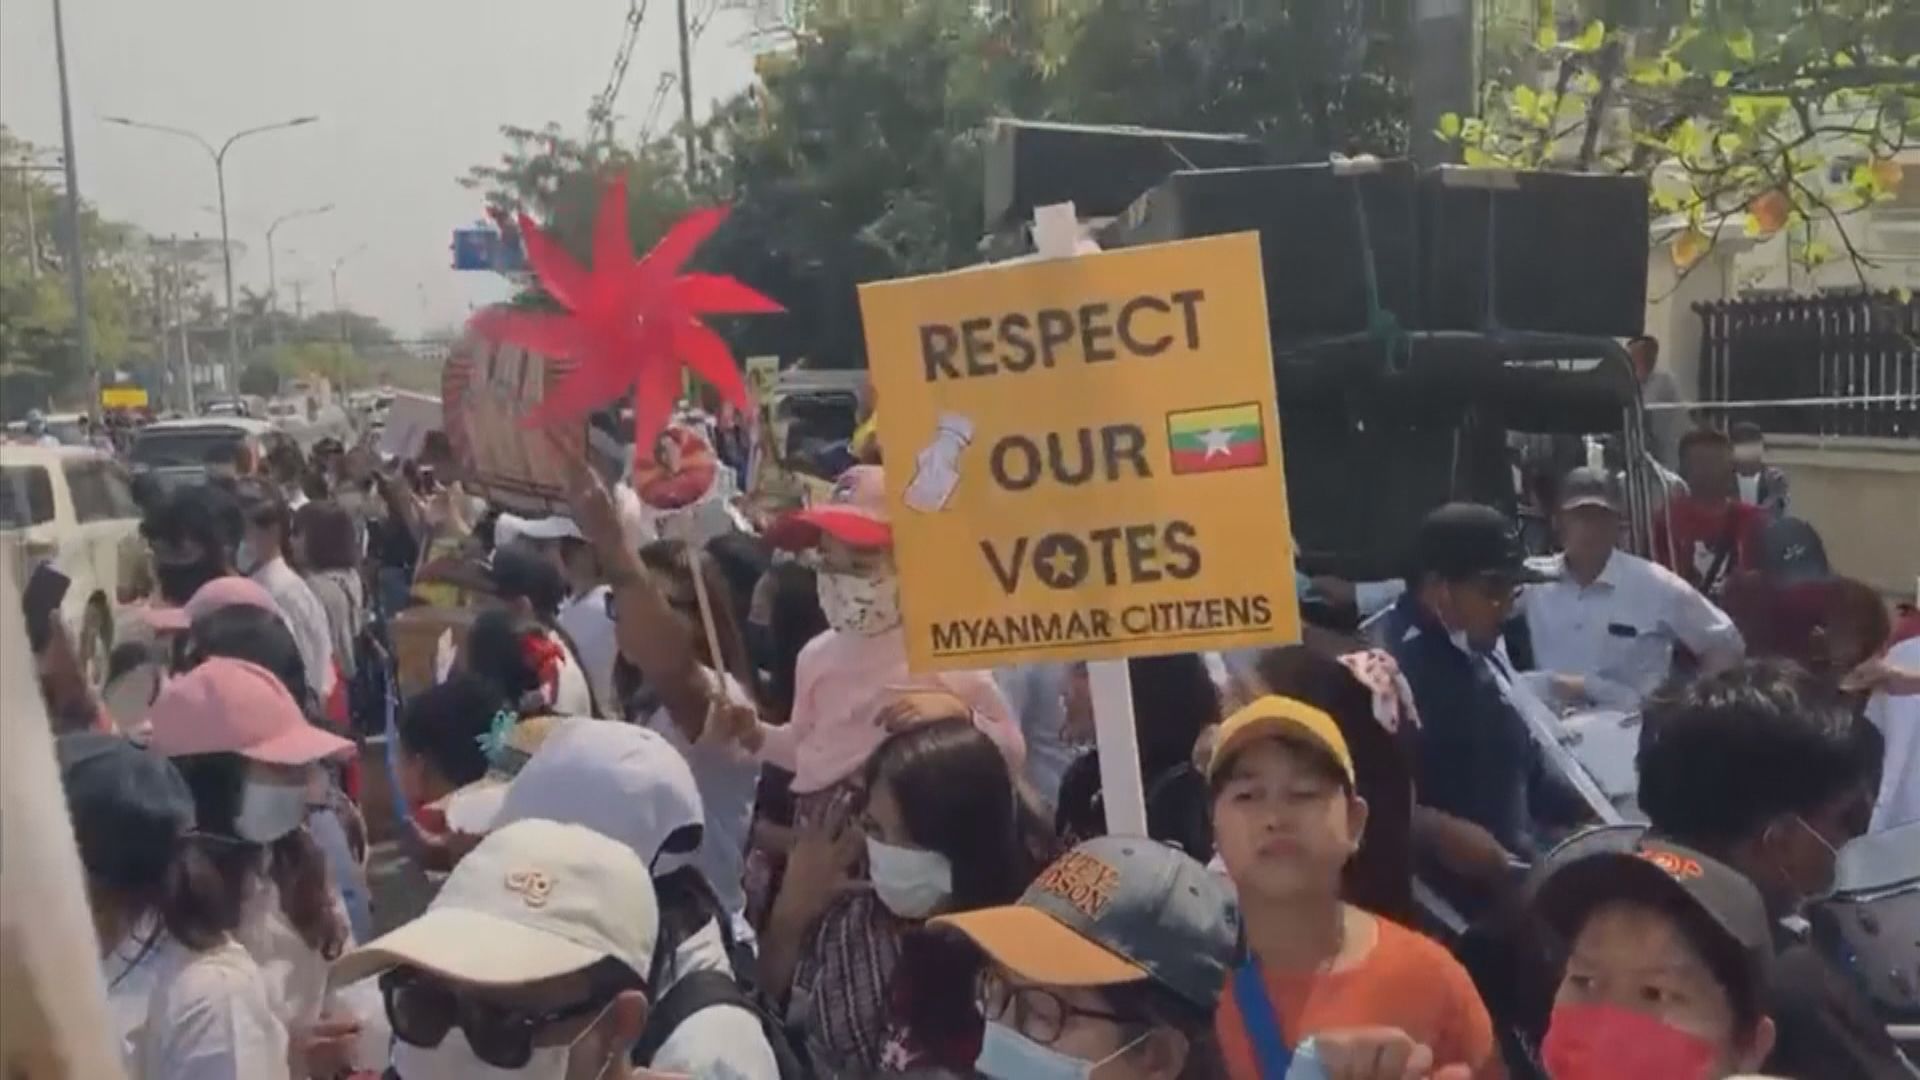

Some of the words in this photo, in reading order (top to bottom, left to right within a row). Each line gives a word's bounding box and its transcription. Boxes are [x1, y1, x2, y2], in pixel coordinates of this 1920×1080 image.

[920, 289, 1205, 382] RESPECT
[990, 424, 1153, 490] OUR
[979, 520, 1202, 595] VOTES
[931, 610, 1112, 651] MYANMAR
[1121, 596, 1273, 634] CITIZENS
